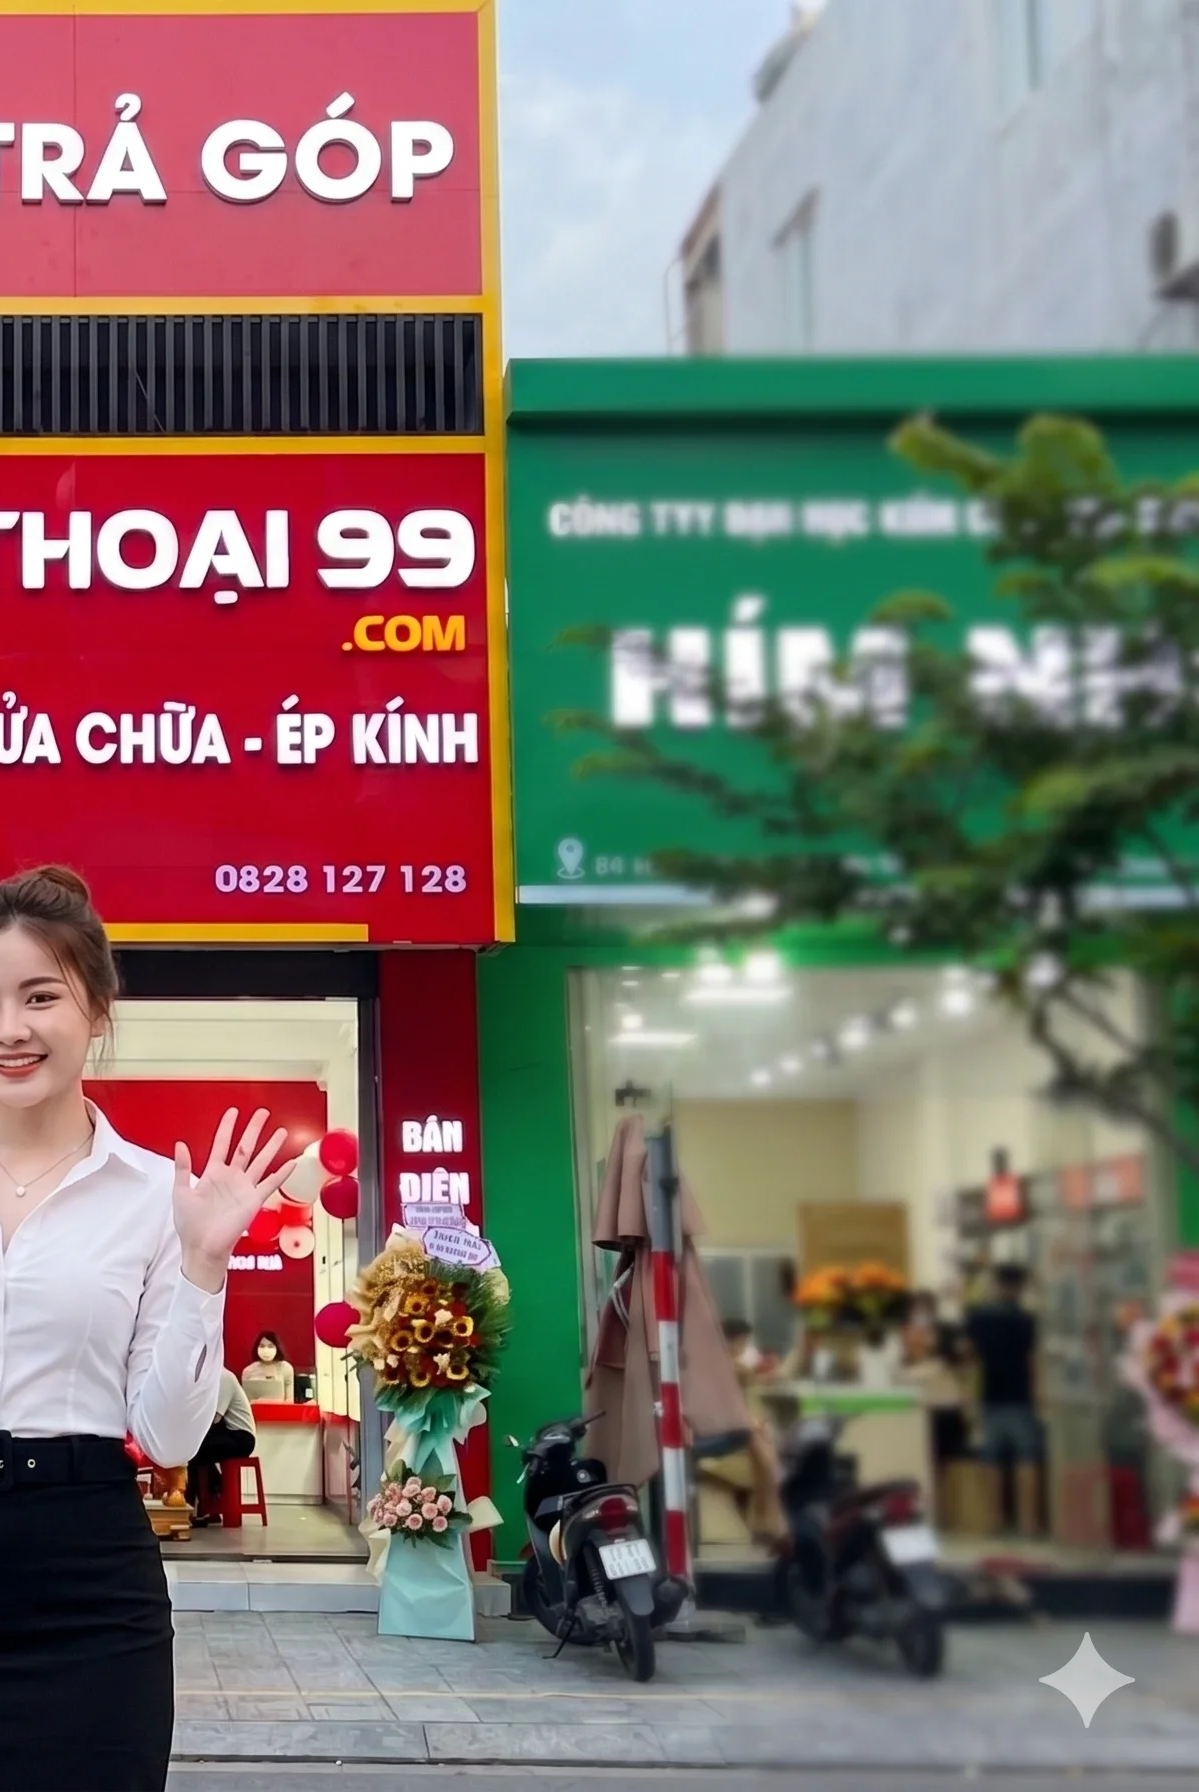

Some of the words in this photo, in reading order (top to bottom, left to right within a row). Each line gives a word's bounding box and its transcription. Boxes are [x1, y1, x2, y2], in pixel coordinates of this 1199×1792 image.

[201, 91, 456, 204] GÓP
[316, 508, 477, 592] 99
[342, 615, 466, 652] .COM
[75, 700, 231, 765] CHỮA
[245, 735, 263, 751] -
[277, 695, 335, 765] ÉP
[352, 697, 479, 765] KÍNH
[214, 865, 309, 894] 0828
[322, 865, 386, 893] 127
[401, 865, 466, 894] 128
[402, 1115, 463, 1152] BÁN
